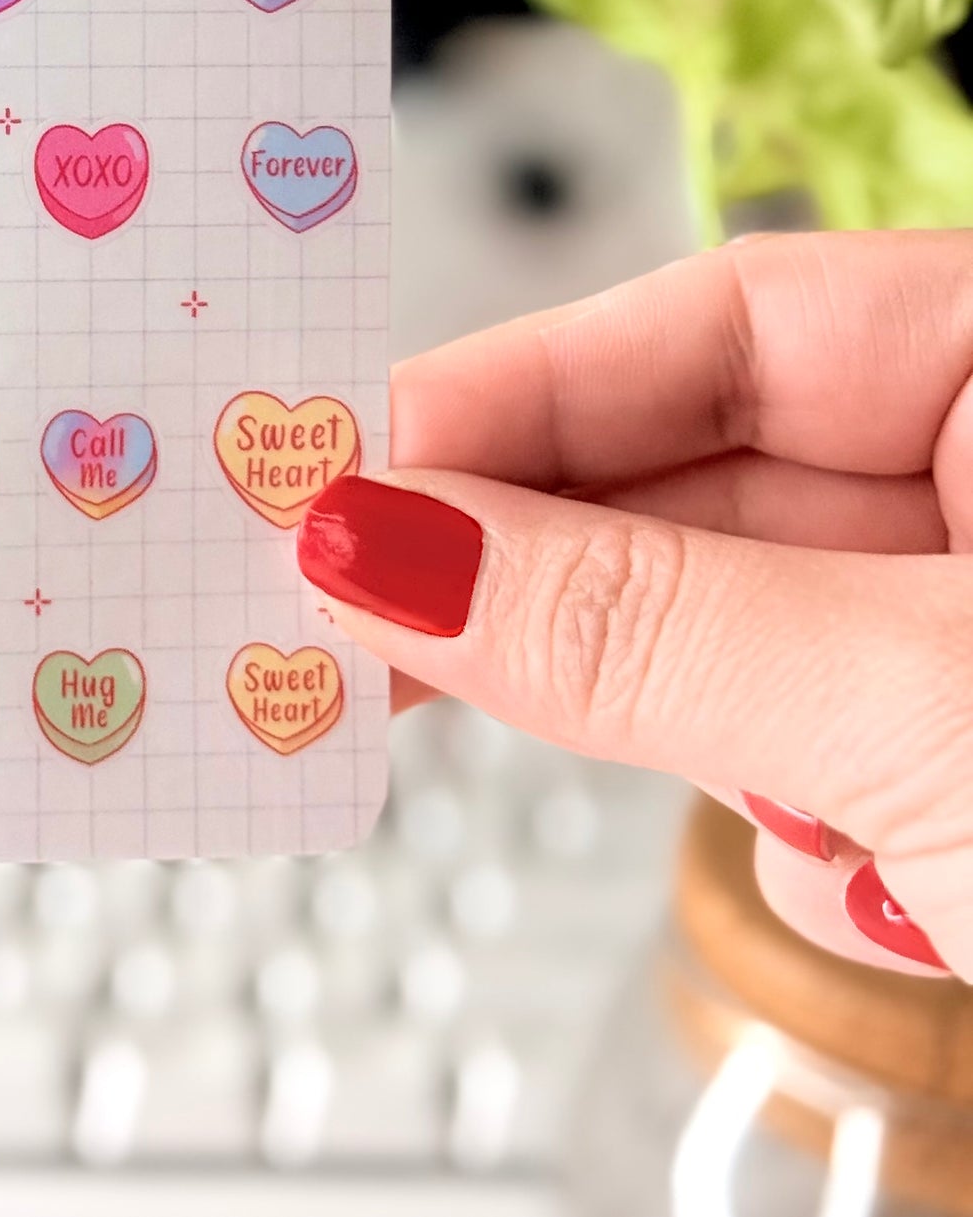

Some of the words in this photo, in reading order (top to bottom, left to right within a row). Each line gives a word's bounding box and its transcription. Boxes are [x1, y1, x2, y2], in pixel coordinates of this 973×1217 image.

[54, 154, 132, 188] XOXO
[251, 150, 346, 179] Forever
[70, 427, 126, 458] Call
[236, 414, 343, 452] Sweet
[80, 462, 118, 489] Me
[246, 457, 332, 488] Heart
[61, 669, 116, 707] Hug
[244, 660, 329, 693] Sweet
[71, 701, 108, 729] Me
[252, 697, 322, 725] Heart
